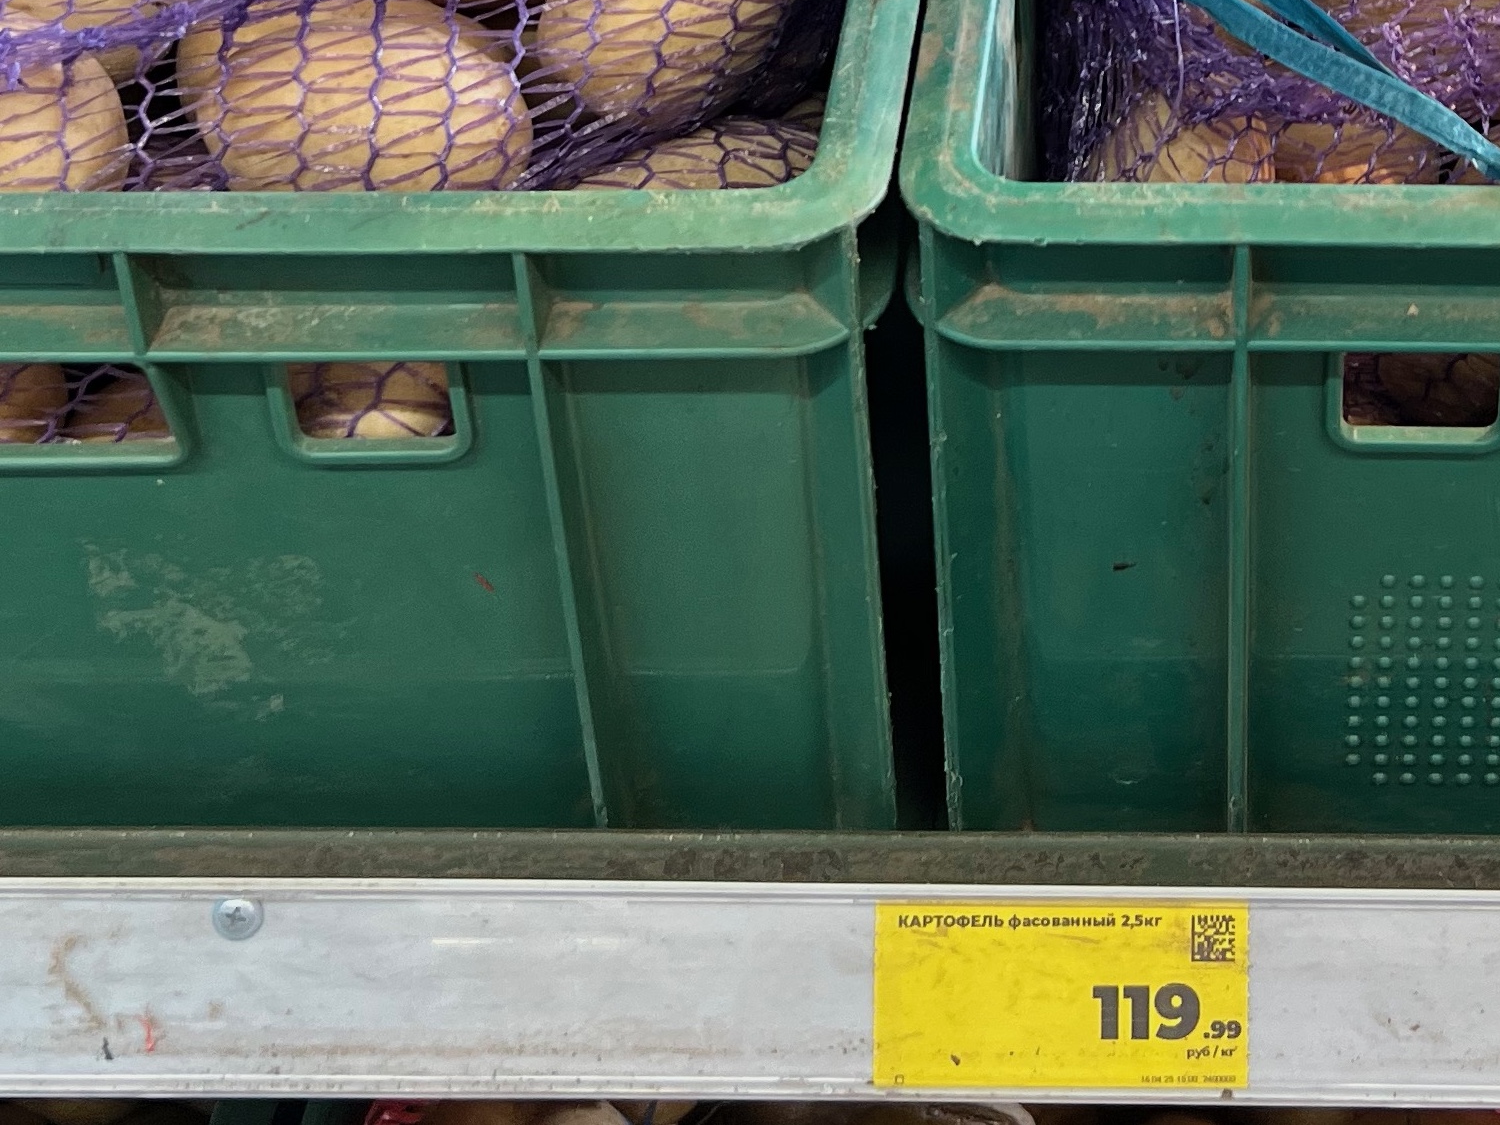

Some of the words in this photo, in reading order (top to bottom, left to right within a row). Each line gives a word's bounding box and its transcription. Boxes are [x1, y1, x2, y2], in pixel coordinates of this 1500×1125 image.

[898, 915, 1004, 928] КАРТОФЕЛЬ
[1008, 914, 1116, 930] фасованный
[1121, 915, 1162, 930] 2,5кг
